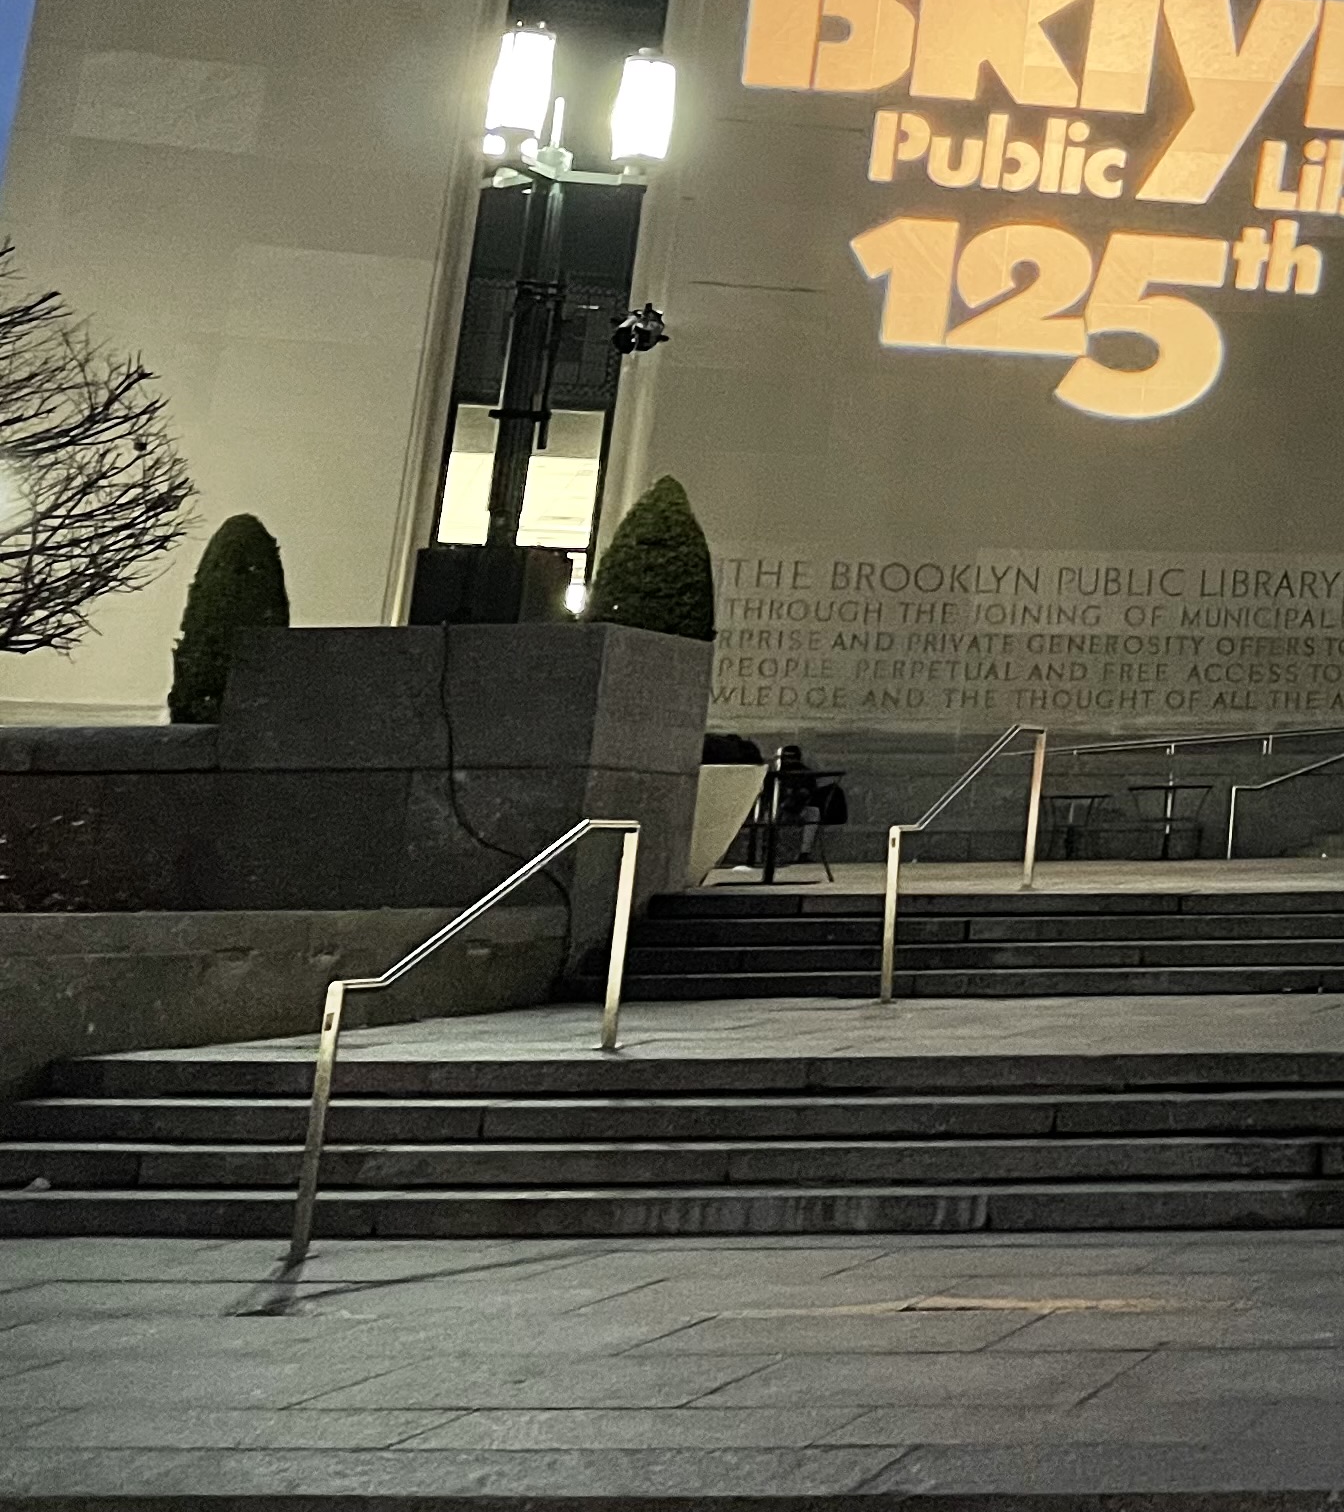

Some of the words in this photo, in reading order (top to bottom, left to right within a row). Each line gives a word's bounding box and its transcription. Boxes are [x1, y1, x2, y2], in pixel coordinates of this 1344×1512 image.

[868, 109, 1128, 198] Public
[728, 558, 811, 590] THE
[831, 560, 1040, 595] BROOKLYN
[1057, 565, 1185, 598] PUBLIC
[1199, 568, 1342, 600] LIBRARY
[725, 597, 884, 625] THROUGH
[900, 601, 958, 624] THE
[973, 602, 1101, 626] JOINING
[1123, 605, 1168, 627] OF
[1180, 605, 1336, 630] MUNICIPAL
[831, 631, 896, 653] AND
[907, 632, 1014, 654] PRIVATE
[1026, 633, 1204, 656] GENEROSITY
[1214, 635, 1316, 657] OFFERS
[717, 657, 834, 679] PEOPLE
[855, 658, 1020, 682] PERPETUAL
[1028, 661, 1088, 682] AND
[1101, 662, 1169, 683] FREE
[1186, 662, 1298, 684] ACCESS
[1311, 663, 1342, 683] TO
[862, 687, 926, 709] AND
[944, 688, 998, 710] THE
[1014, 689, 1156, 710] THOUGHT
[1165, 689, 1202, 710] OF
[1211, 690, 1259, 710] ALL
[1270, 690, 1323, 710] THE
